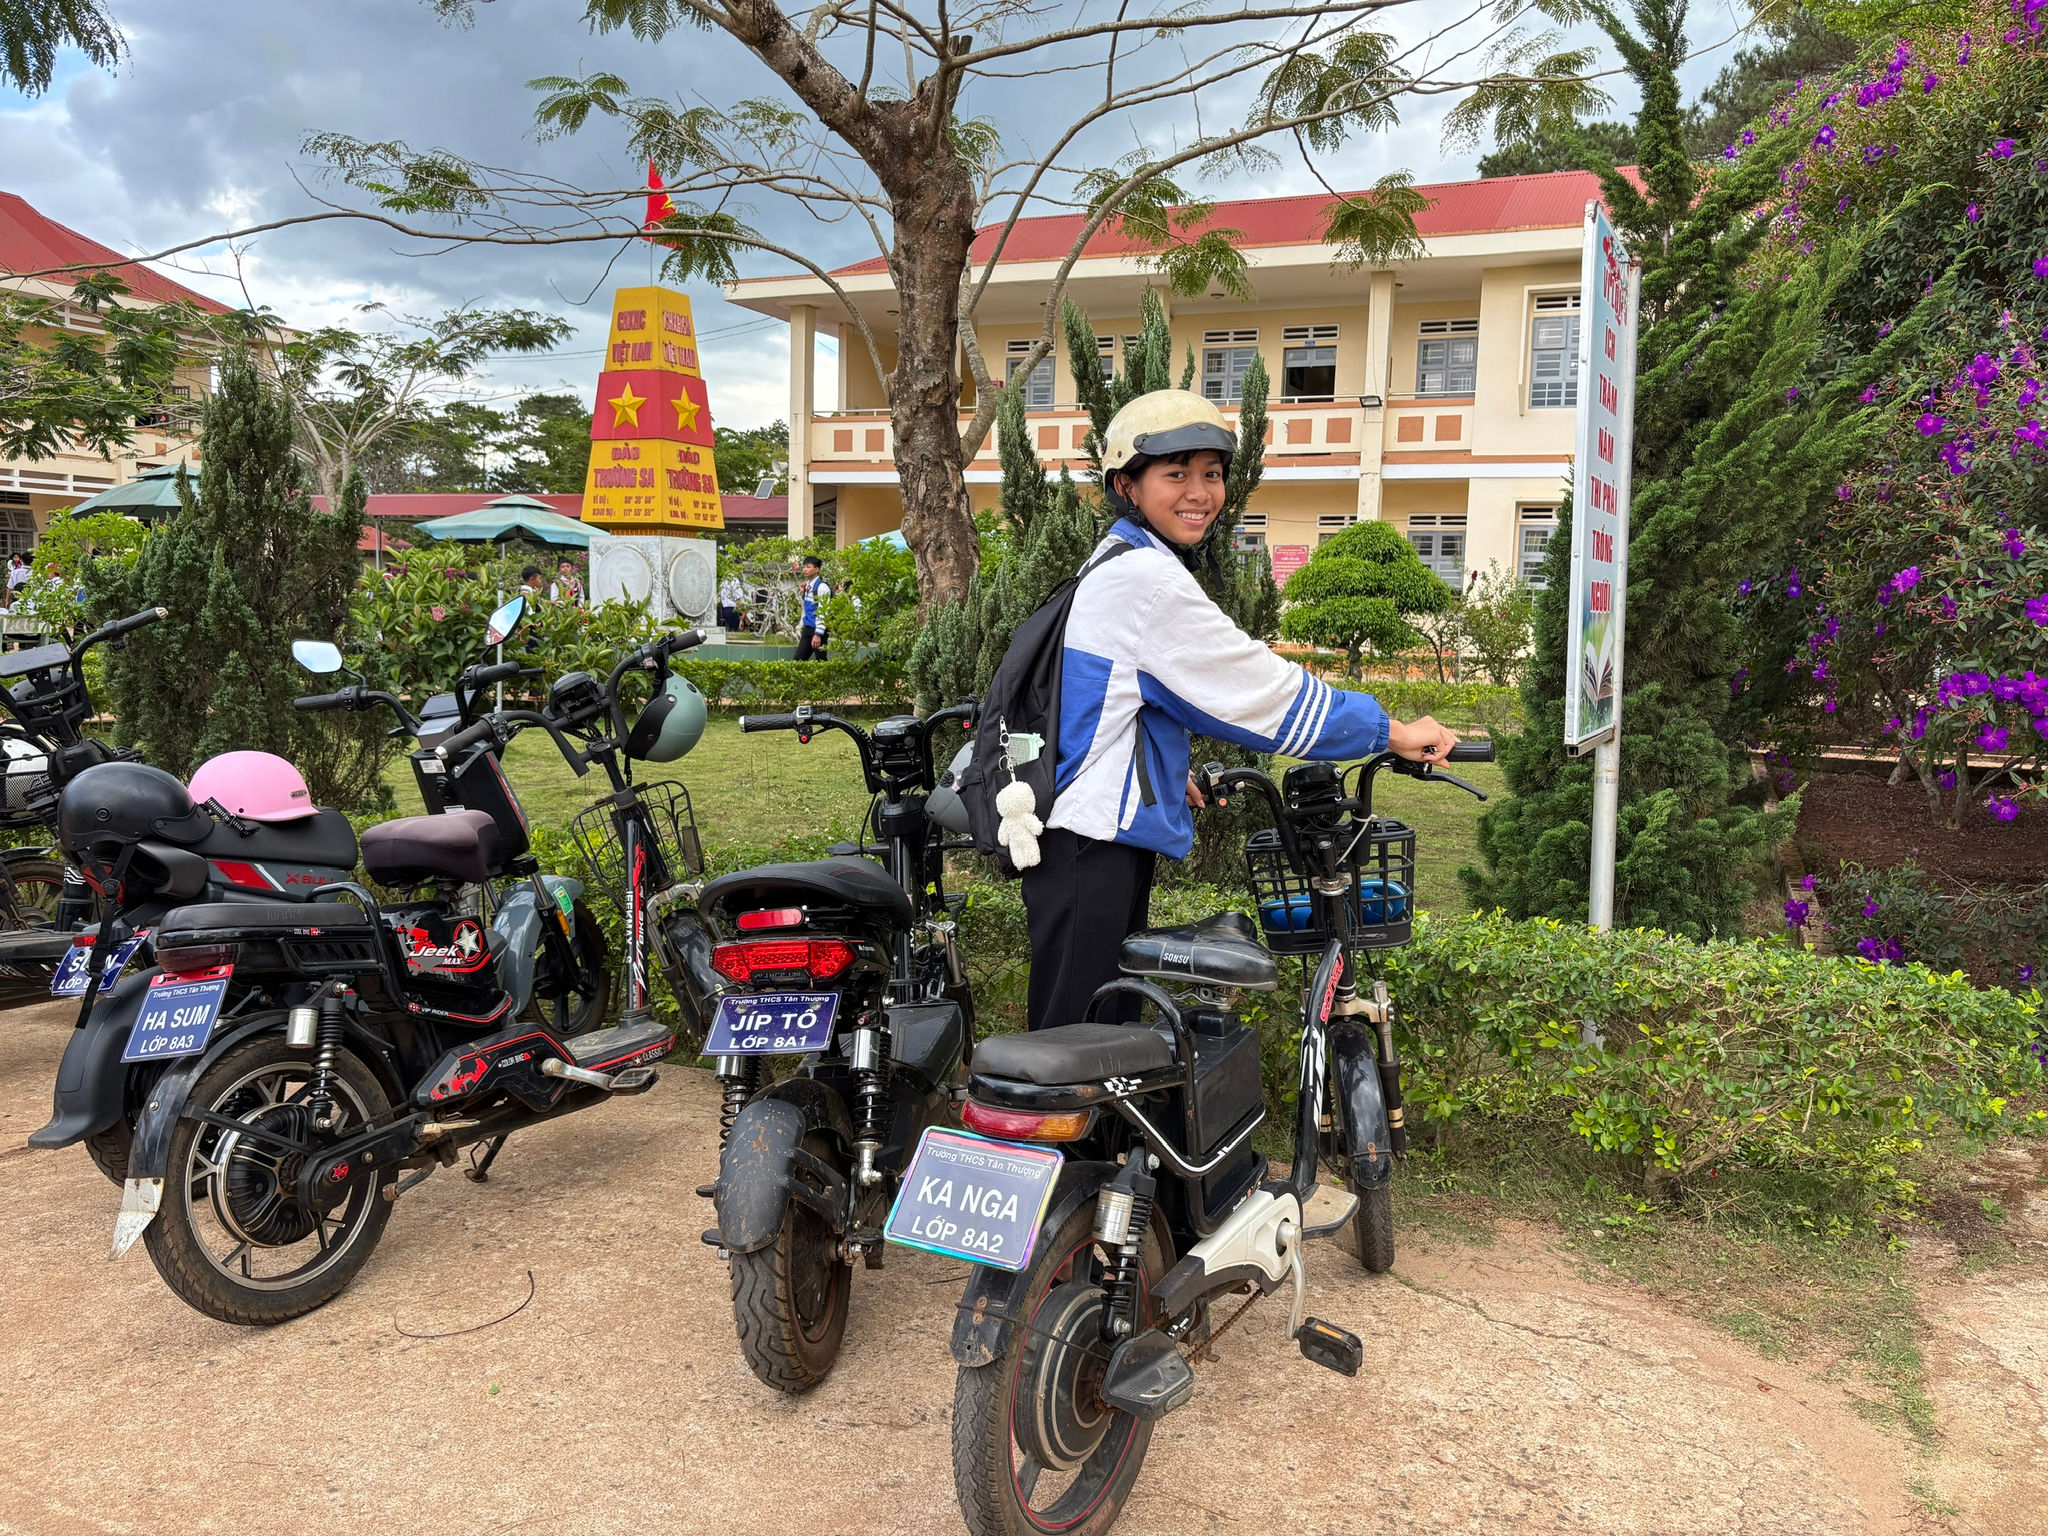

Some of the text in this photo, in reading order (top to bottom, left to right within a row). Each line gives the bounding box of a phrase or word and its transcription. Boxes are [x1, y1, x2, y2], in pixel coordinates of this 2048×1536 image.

[613, 339, 653, 367] VIỆT NAM
[663, 341, 697, 369] VIỆT NAM
[611, 442, 640, 461] ĐẢO
[678, 446, 701, 465] ĐẢO
[593, 463, 655, 488] TRƯỜNG SA
[665, 465, 716, 494] TRƯỜNG SA
[408, 944, 460, 957] Jeek
[1163, 952, 1190, 964] SONSU
[442, 957, 462, 965] MAX
[173, 988, 188, 996] THCS
[730, 998, 758, 1006] Trường
[142, 1004, 211, 1031] HA SUM
[730, 1009, 818, 1031] JÍP TÔ
[140, 1034, 195, 1053] LỚP 8A3
[729, 1034, 808, 1049] LỚP 8A1
[927, 1147, 1042, 1179] Trường THCS Tân Thượng
[916, 1175, 1019, 1222] KA NGA
[911, 1214, 1004, 1253] LỚP 8A2
